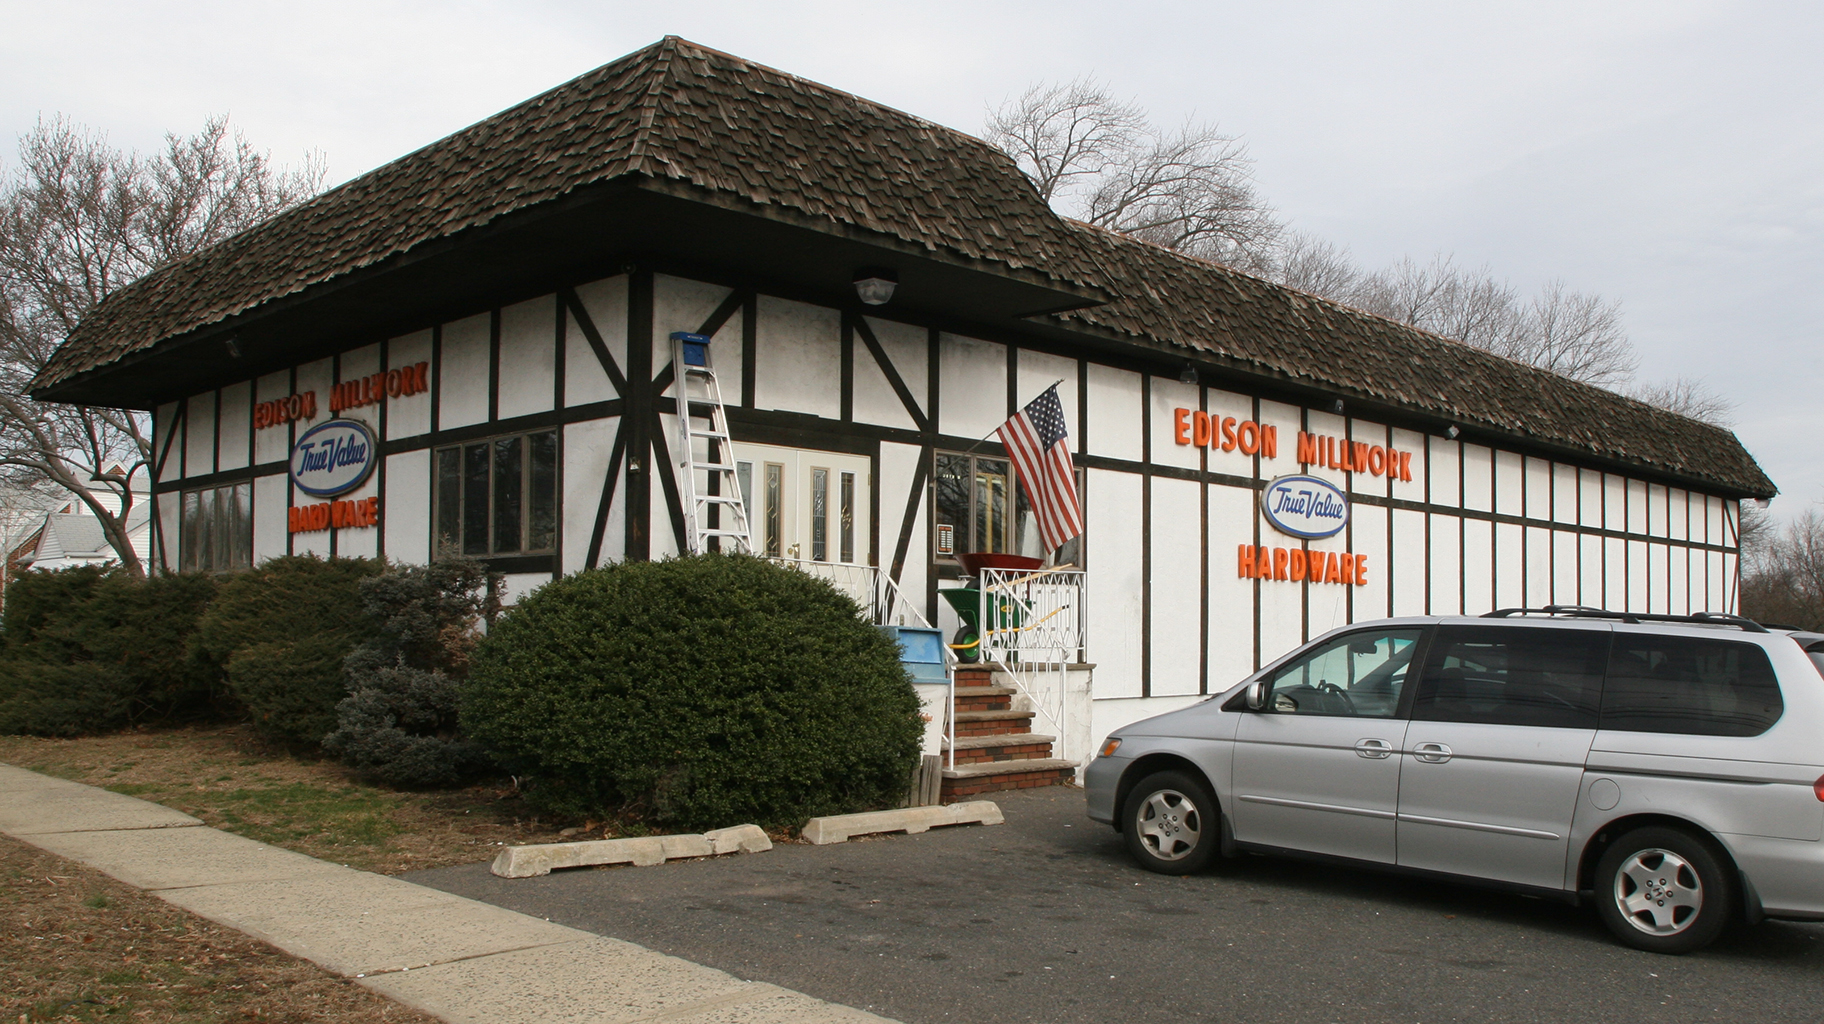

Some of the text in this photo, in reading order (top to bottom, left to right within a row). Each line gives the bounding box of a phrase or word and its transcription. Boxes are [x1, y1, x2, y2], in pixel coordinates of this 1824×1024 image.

[254, 361, 428, 428] EDISON MILLWORK
[1175, 408, 1412, 482] EDISON MILLWORK
[288, 497, 378, 532] HARDWARE
[1238, 544, 1367, 585] HARDWARE
